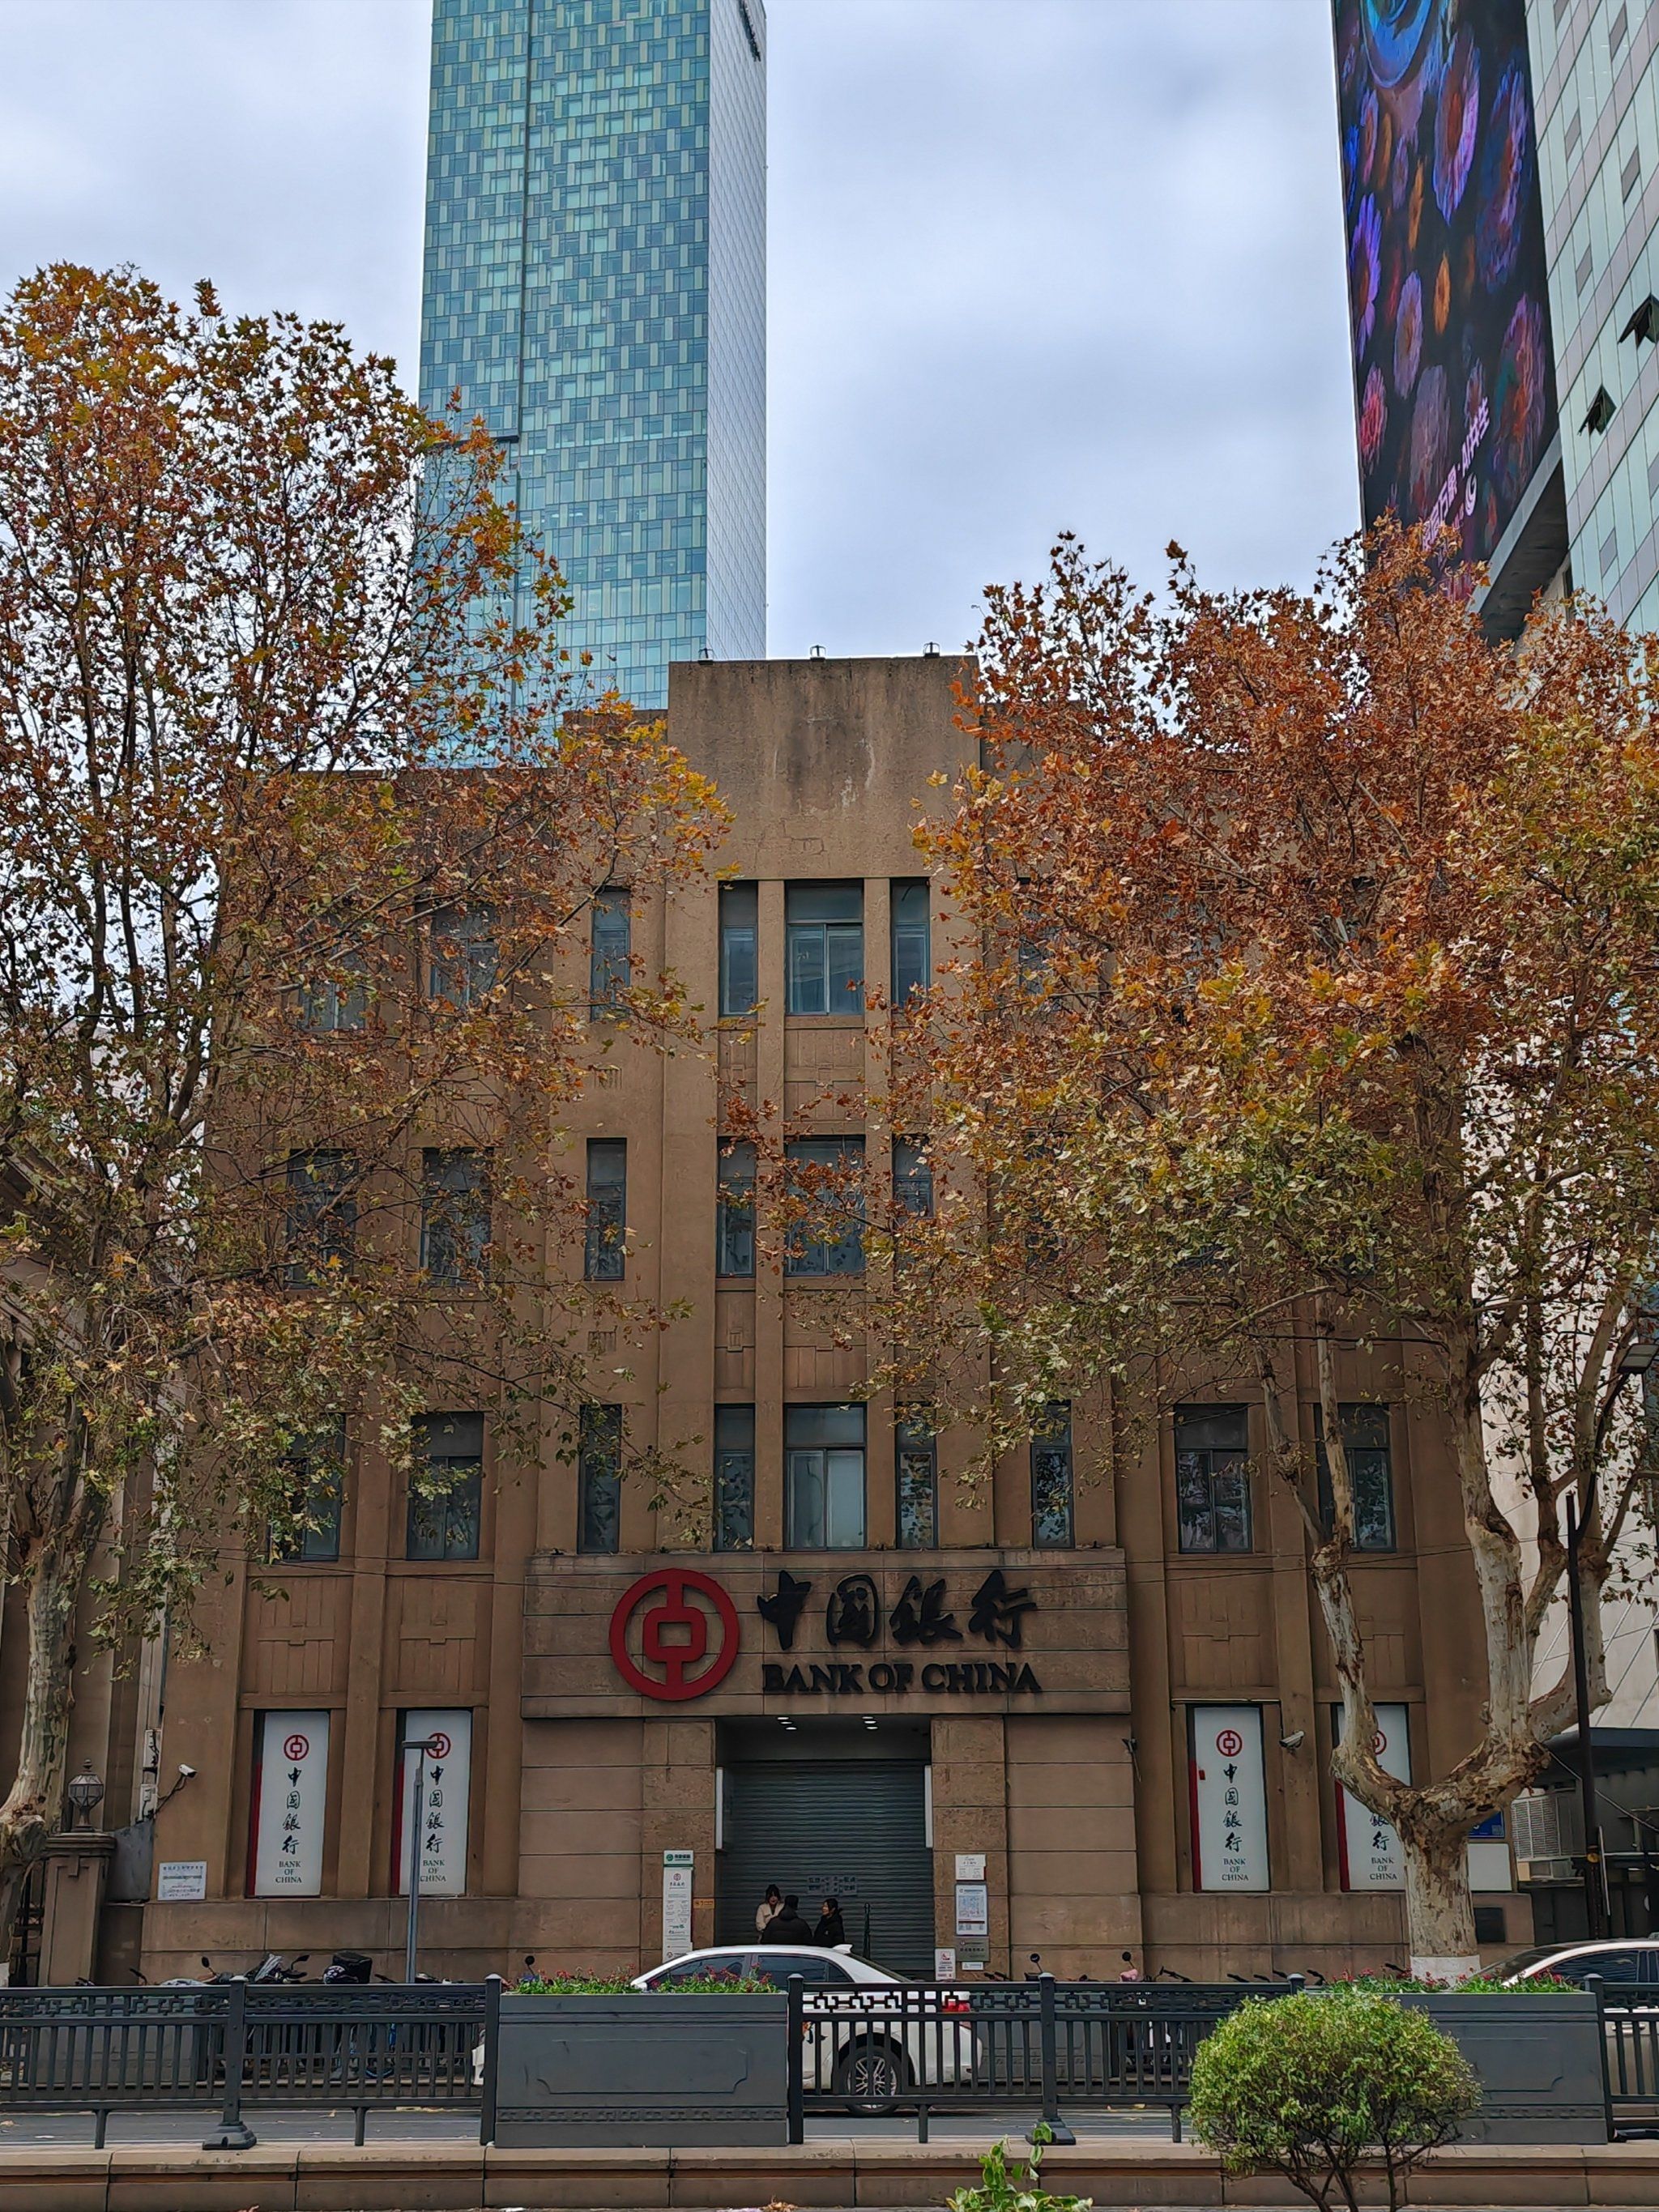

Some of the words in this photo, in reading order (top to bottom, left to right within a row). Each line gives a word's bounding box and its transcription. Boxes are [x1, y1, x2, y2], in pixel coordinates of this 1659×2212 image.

[762, 1663, 863, 1692] BANK
[868, 1663, 913, 1692] OF
[921, 1662, 1041, 1693] CHINA
[1222, 1873, 1248, 1882] CHINA
